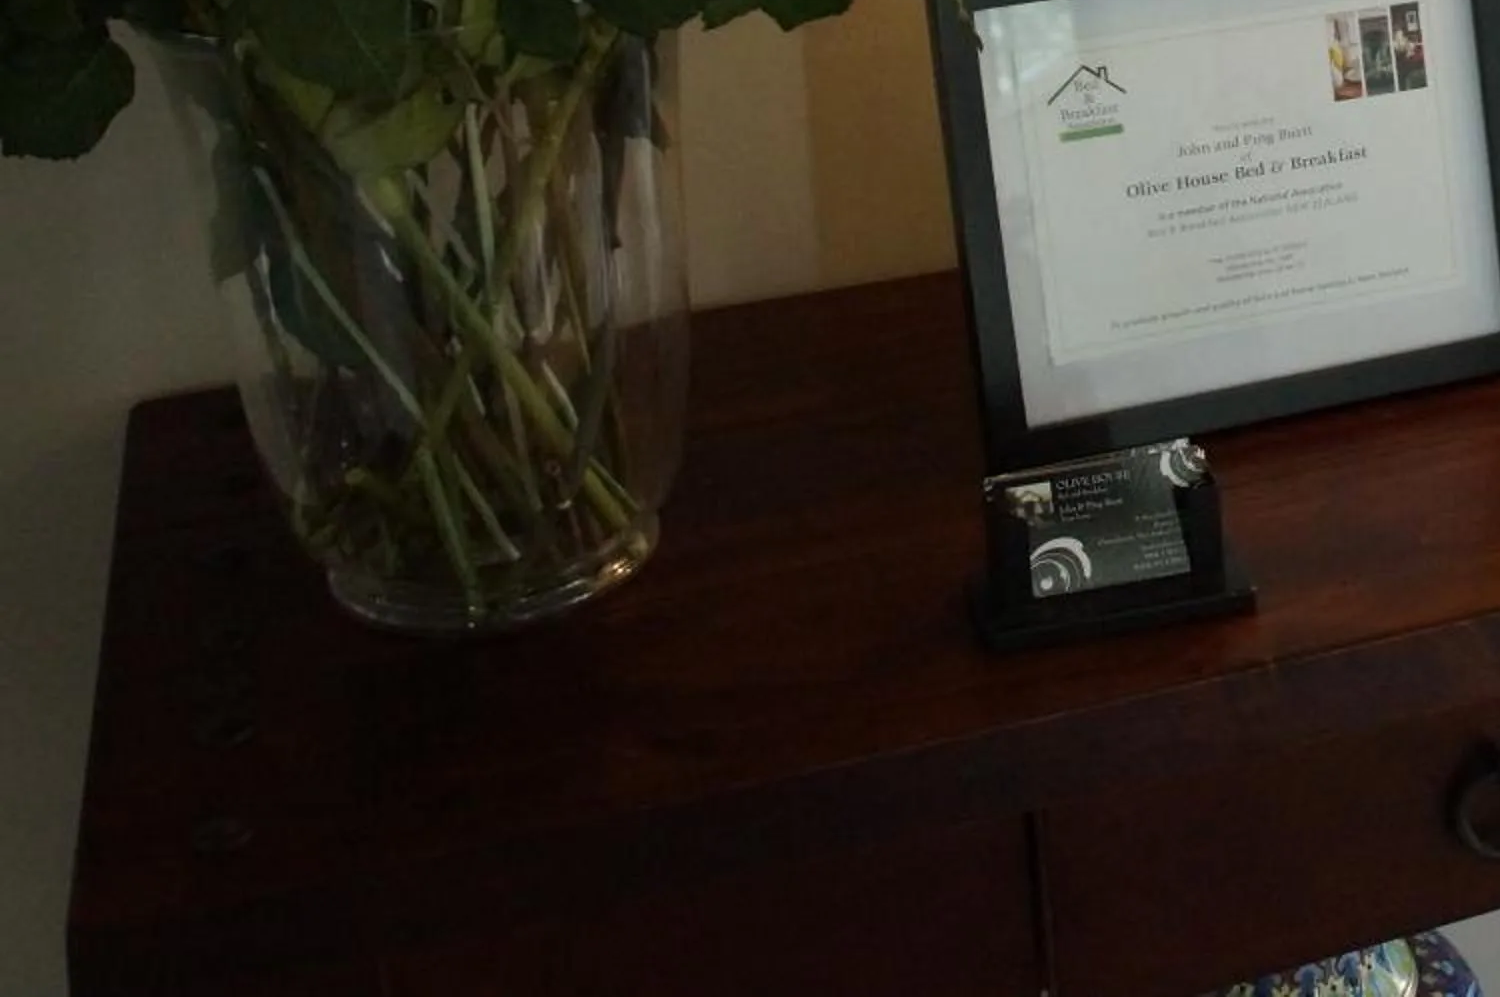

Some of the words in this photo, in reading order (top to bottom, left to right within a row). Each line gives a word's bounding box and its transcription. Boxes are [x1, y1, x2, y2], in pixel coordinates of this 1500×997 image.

[1177, 144, 1211, 158] John
[1213, 136, 1239, 152] and
[1243, 133, 1274, 149] Ping
[1126, 180, 1170, 199] Olive
[1176, 171, 1229, 191] House
[1234, 160, 1265, 180] Bed
[1270, 161, 1284, 174] &
[1290, 146, 1368, 171] Breakfast
